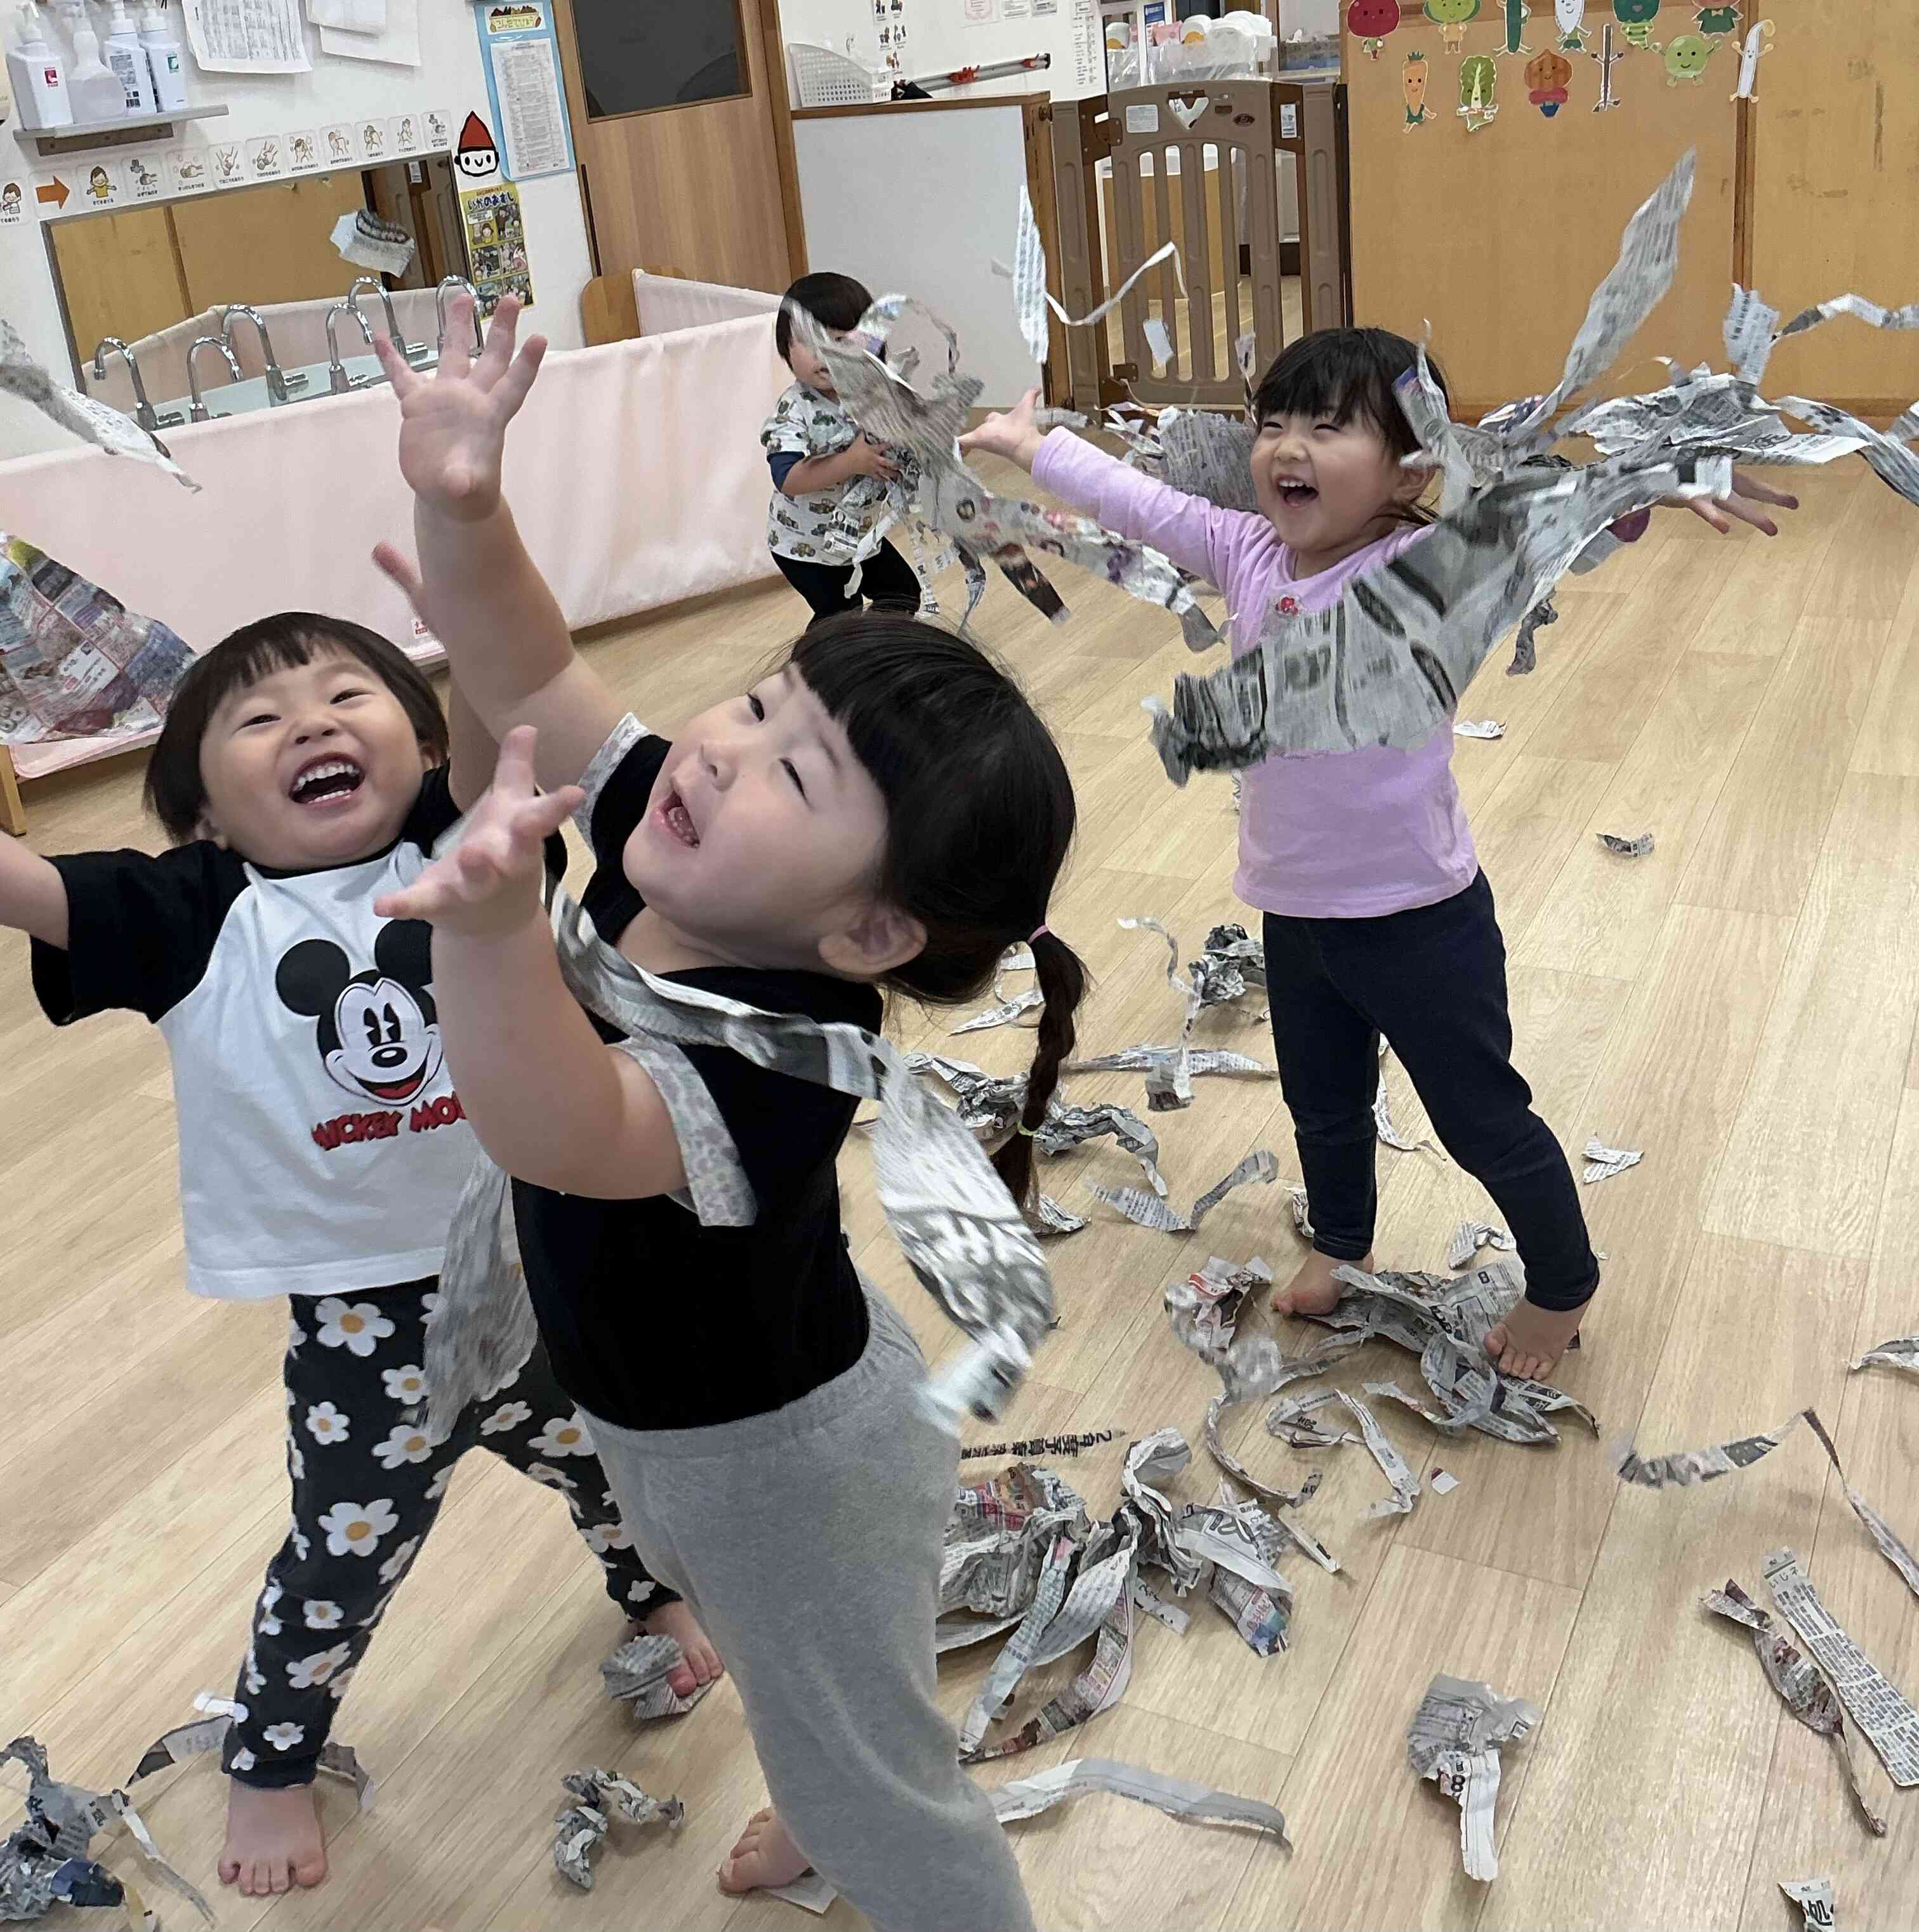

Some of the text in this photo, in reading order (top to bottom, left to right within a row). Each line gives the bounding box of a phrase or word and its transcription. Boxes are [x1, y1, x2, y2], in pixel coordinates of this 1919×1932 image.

[467, 192, 514, 211] いかのおすし
